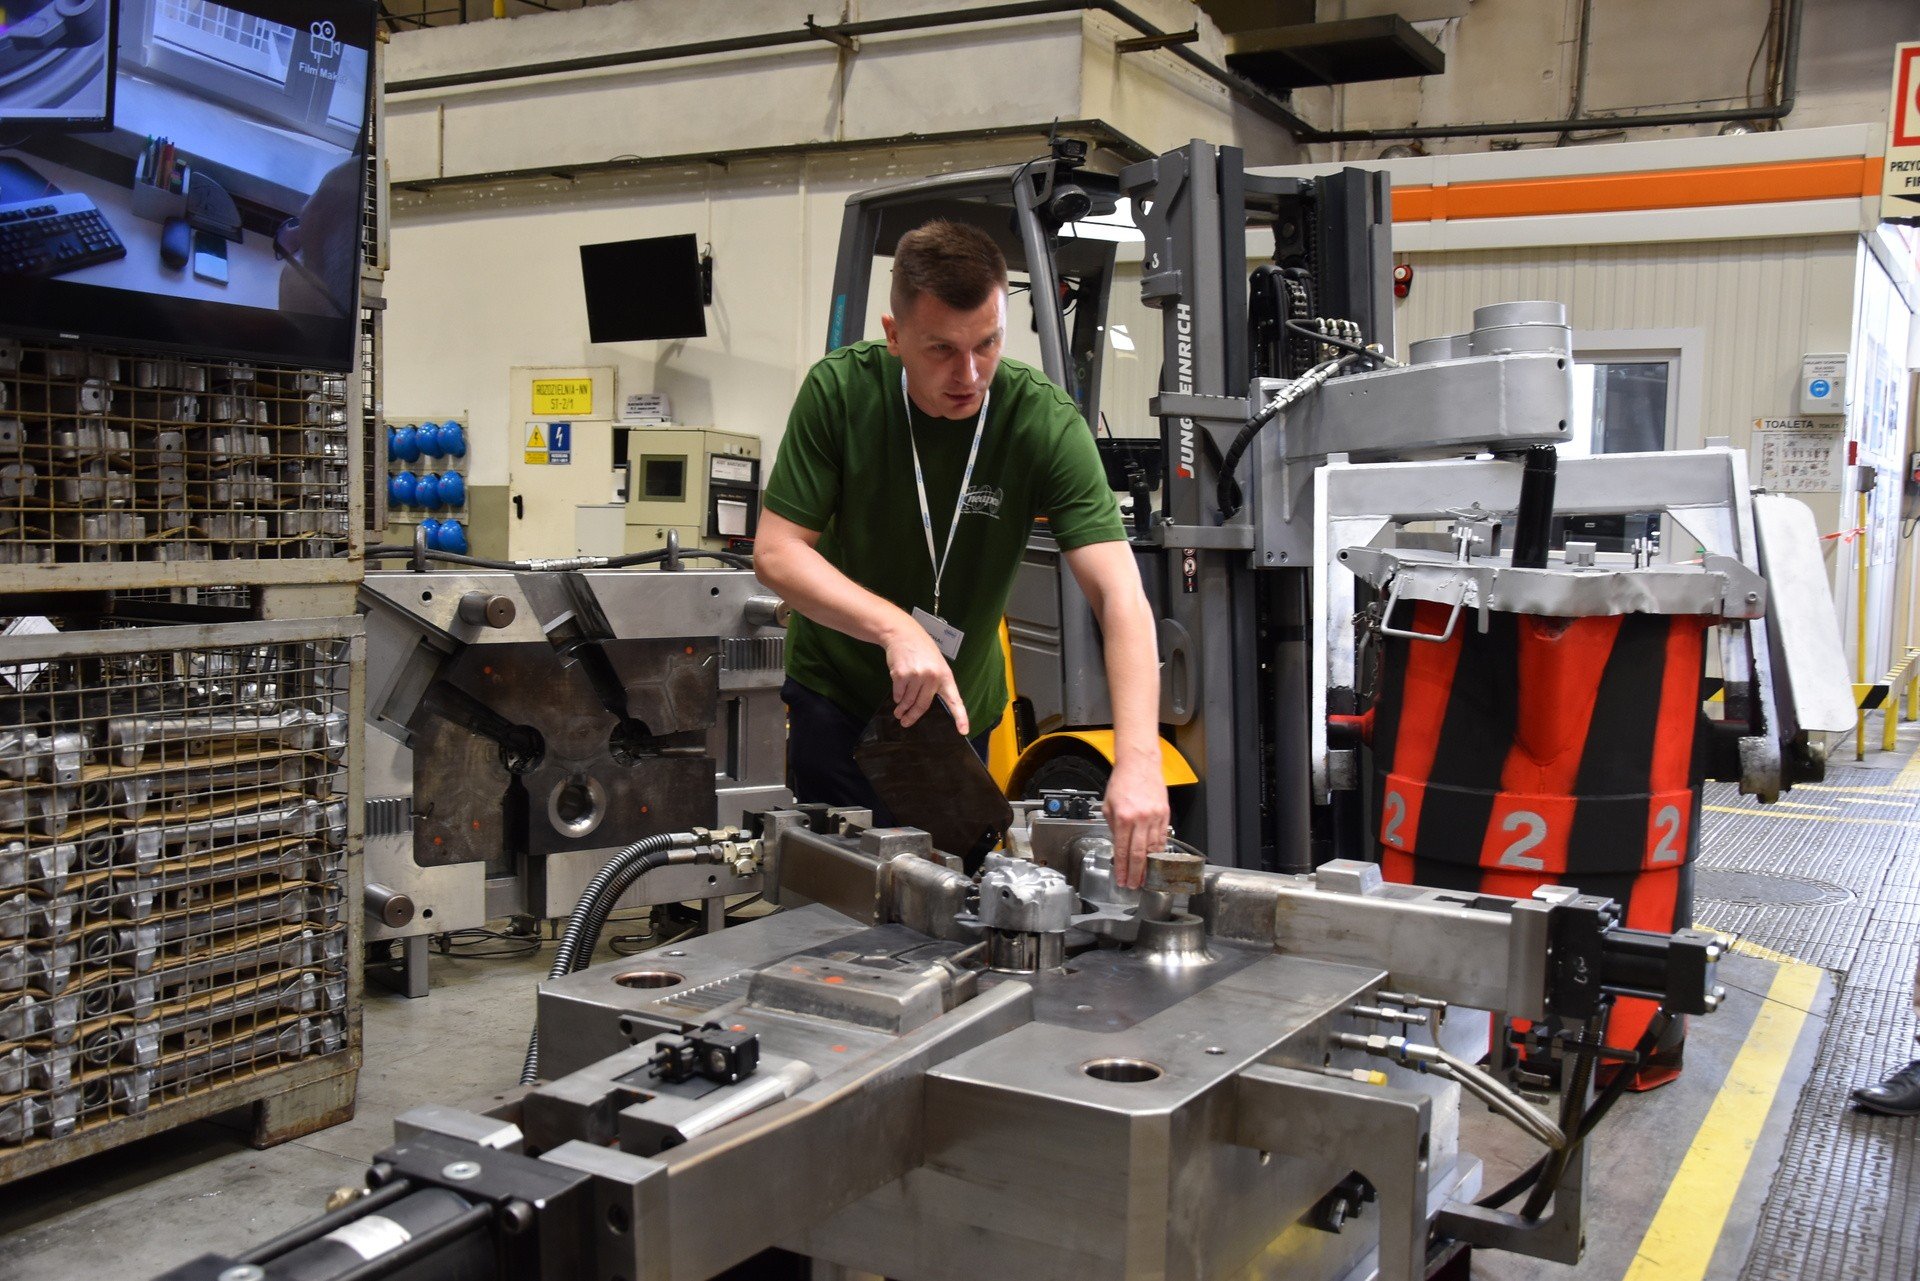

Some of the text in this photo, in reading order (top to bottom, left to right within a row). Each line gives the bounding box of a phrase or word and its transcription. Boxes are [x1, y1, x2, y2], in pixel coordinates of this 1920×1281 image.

[299, 61, 318, 75] Film
[1176, 304, 1194, 479] JUNGEINRICH
[1765, 420, 1814, 429] TOALETA
[1385, 791, 1406, 847] 2
[1499, 810, 1548, 870] 2
[1652, 805, 1680, 862] 2
